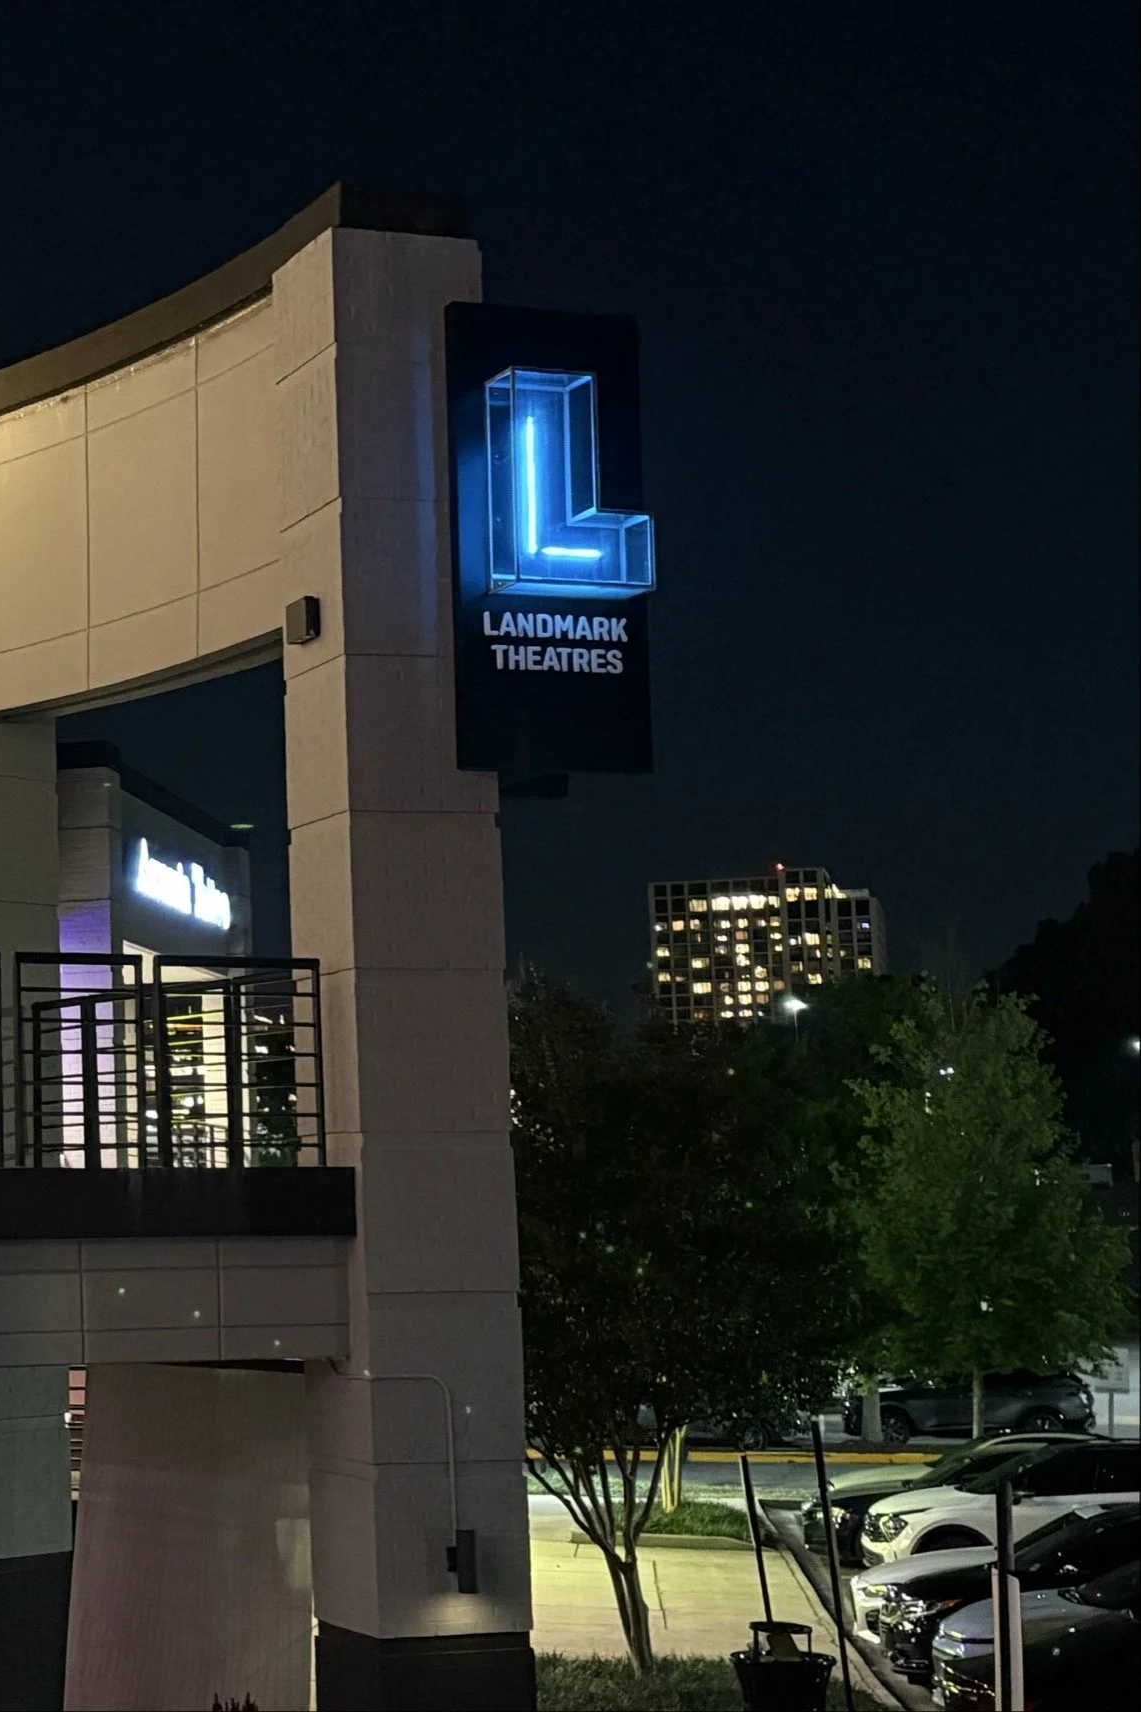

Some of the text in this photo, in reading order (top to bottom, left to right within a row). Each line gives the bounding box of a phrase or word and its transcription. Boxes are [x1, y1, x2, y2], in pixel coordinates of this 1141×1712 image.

[485, 366, 656, 598] L
[483, 610, 629, 643] LANDMARK
[490, 644, 624, 674] THEATRES
